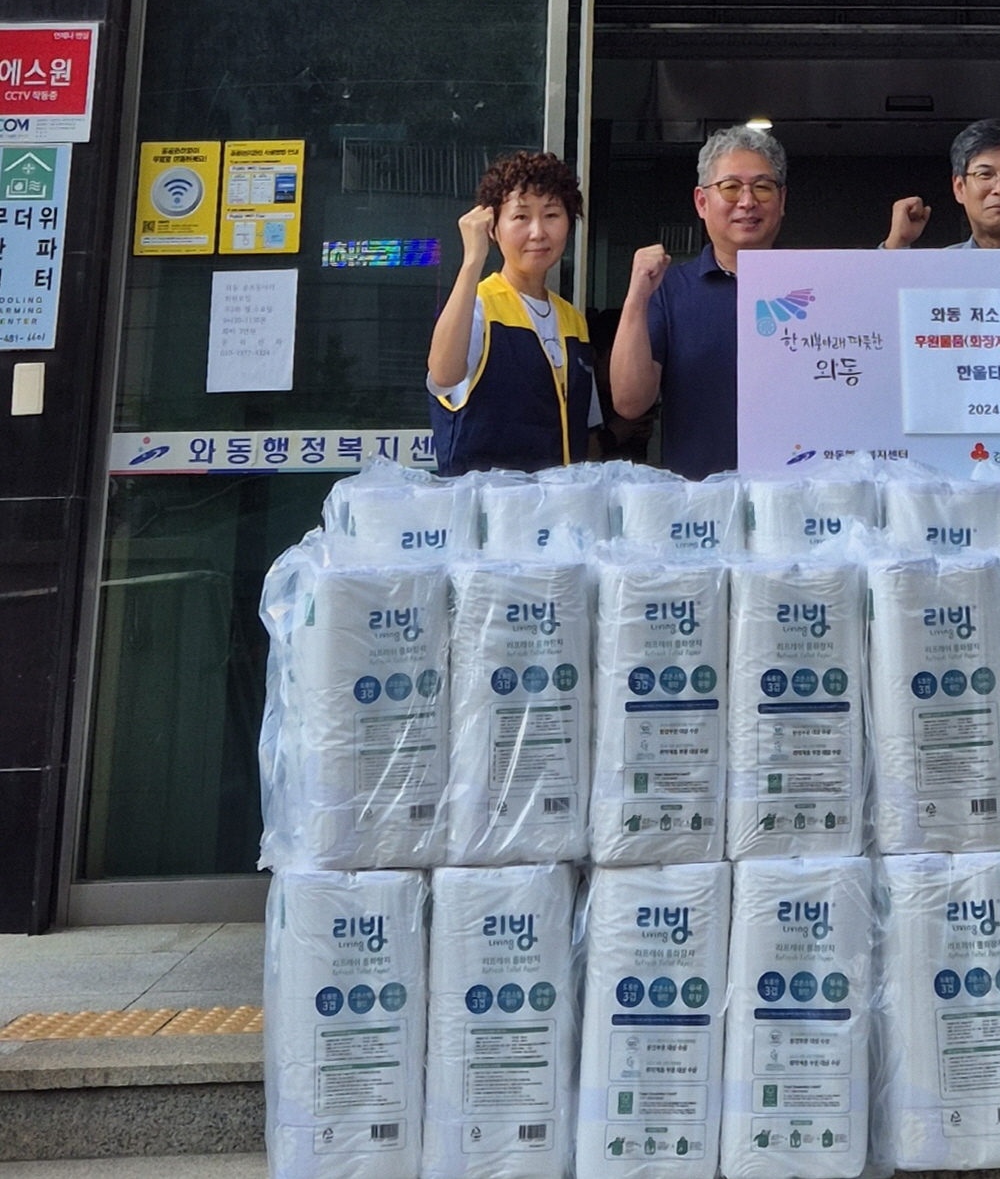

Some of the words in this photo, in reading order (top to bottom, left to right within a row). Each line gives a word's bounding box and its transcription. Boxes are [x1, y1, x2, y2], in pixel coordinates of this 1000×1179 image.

[0, 58, 72, 86] 에스원
[5, 91, 31, 101] CCTV
[32, 91, 58, 101] 작동중
[931, 307, 961, 322] 와동
[780, 327, 798, 352] 한
[813, 358, 863, 386] 와동
[369, 608, 423, 642] 리빙
[507, 602, 560, 635] 리빙
[645, 601, 699, 635] 리빙
[776, 604, 831, 638] 리빙
[924, 606, 976, 640] 리빙
[483, 914, 538, 951] 리빙
[637, 907, 693, 945] 리빙
[777, 901, 833, 940] 리빙
[783, 925, 808, 937] Living
[947, 899, 1000, 936] 리빙
[952, 924, 977, 935] Living
[333, 916, 388, 953] 리빙
[338, 941, 364, 952] Living
[489, 939, 514, 950] Living
[642, 931, 667, 942] Living
